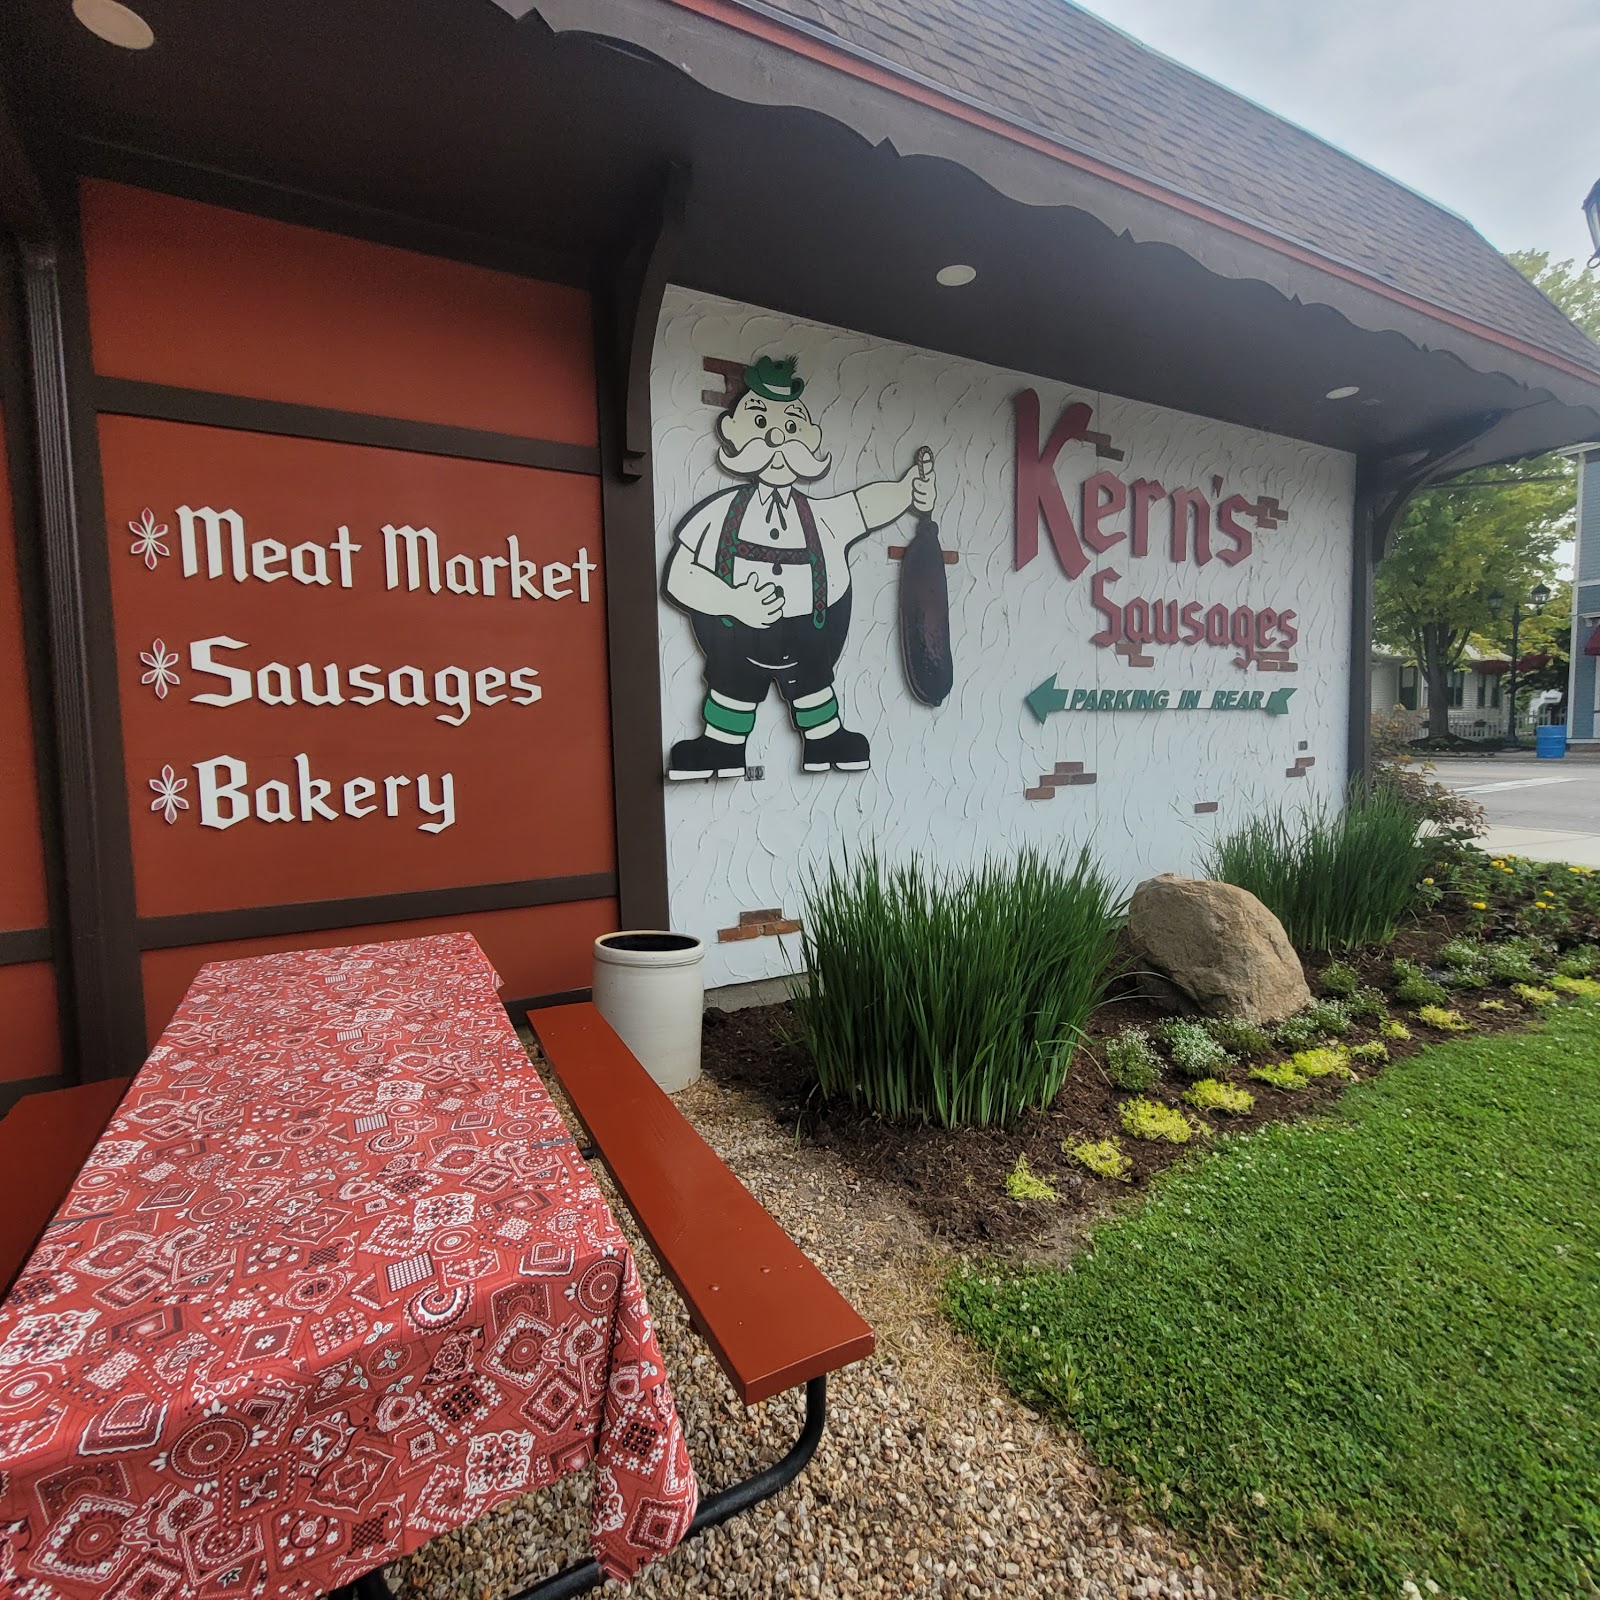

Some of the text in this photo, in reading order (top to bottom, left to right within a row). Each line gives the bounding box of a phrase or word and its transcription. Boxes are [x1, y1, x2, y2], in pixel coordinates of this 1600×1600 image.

[1015, 388, 1252, 580] Kern's
[175, 505, 597, 602] Meat Market
[1089, 567, 1297, 670] Sausages
[189, 635, 542, 726] Sausages
[1069, 689, 1264, 710] PARKING IN REAR
[192, 753, 455, 834] Bakery
